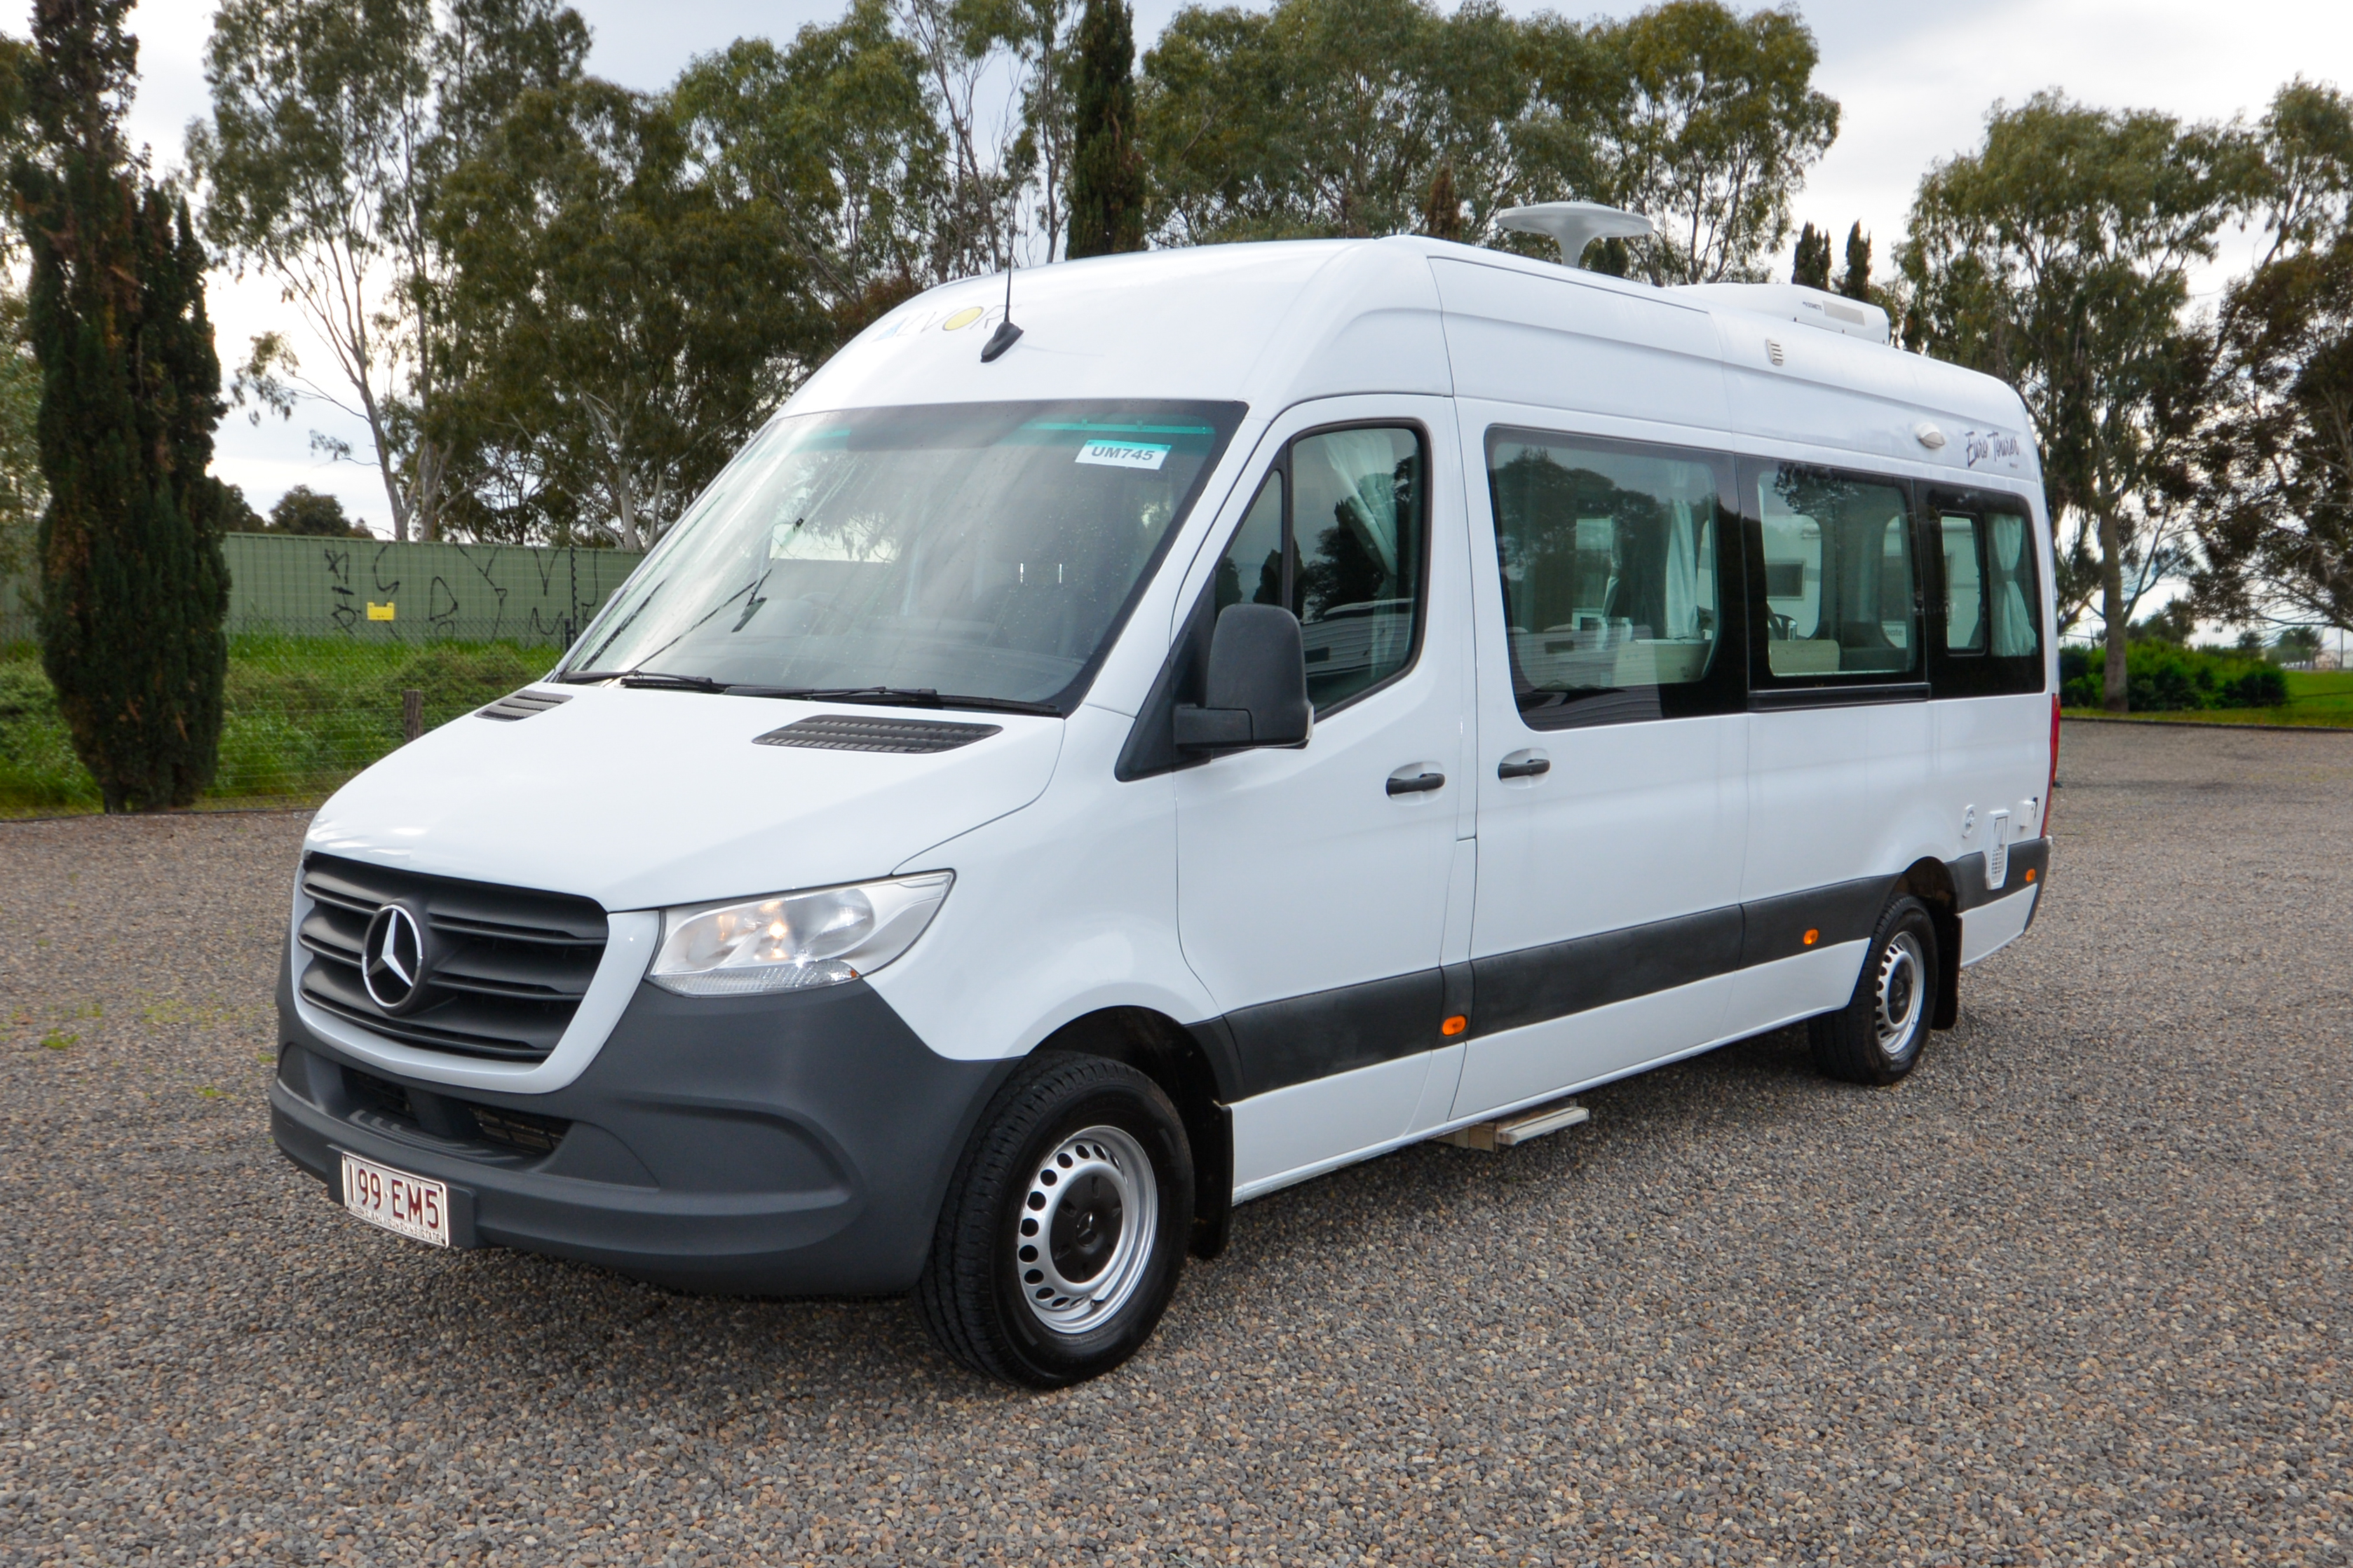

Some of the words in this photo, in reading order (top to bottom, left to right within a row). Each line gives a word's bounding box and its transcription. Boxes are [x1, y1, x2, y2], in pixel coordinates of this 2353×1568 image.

[1091, 446, 1155, 461] UM745
[1965, 430, 1988, 468] Euro
[1987, 430, 2019, 463] Tourer
[391, 1178, 440, 1229] EM5
